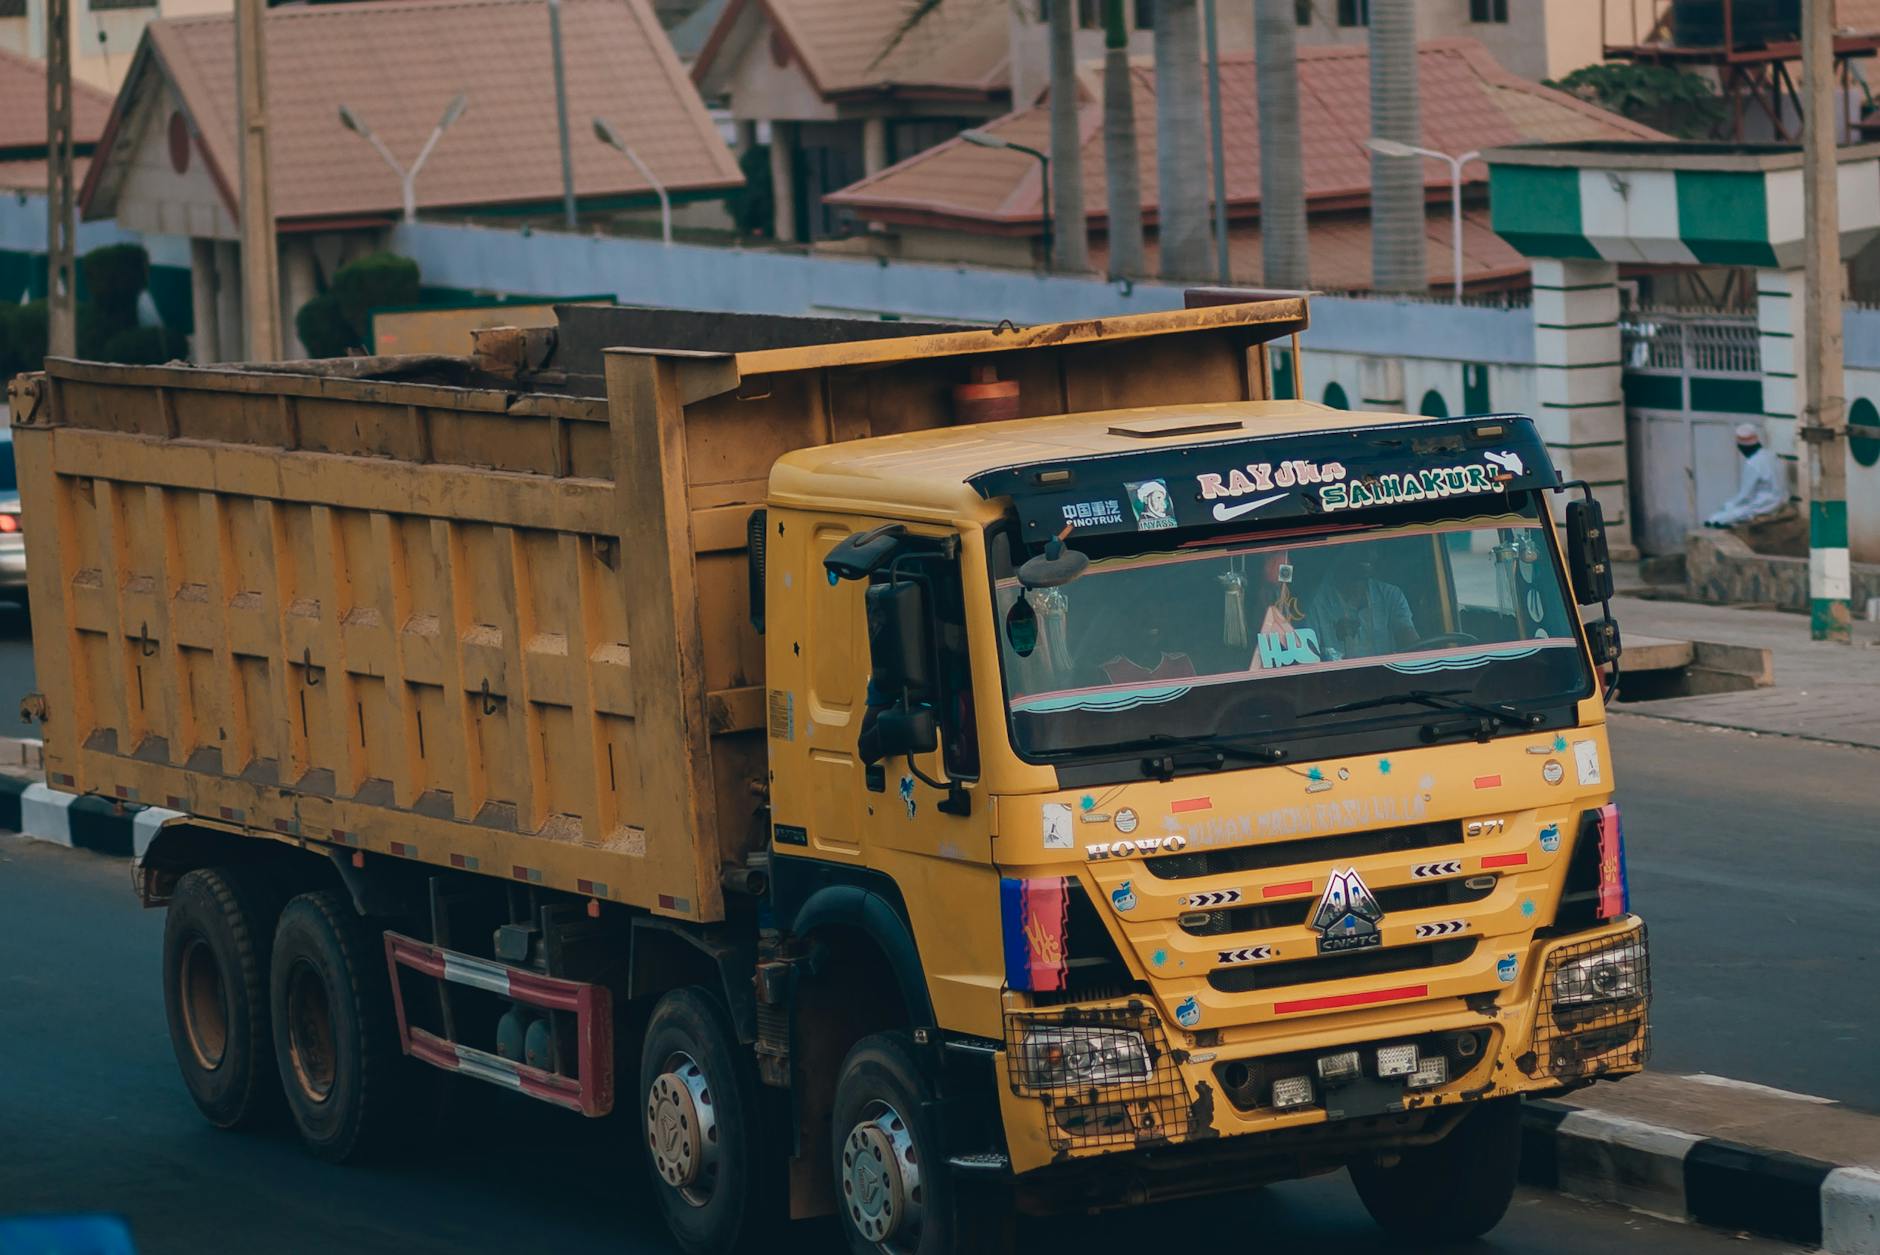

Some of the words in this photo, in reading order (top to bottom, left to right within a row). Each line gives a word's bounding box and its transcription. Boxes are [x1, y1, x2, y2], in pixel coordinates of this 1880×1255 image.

[1062, 499, 1121, 519] 中国重汽
[1085, 835, 1187, 860] HOWO
[1322, 934, 1379, 950] CNHTC
